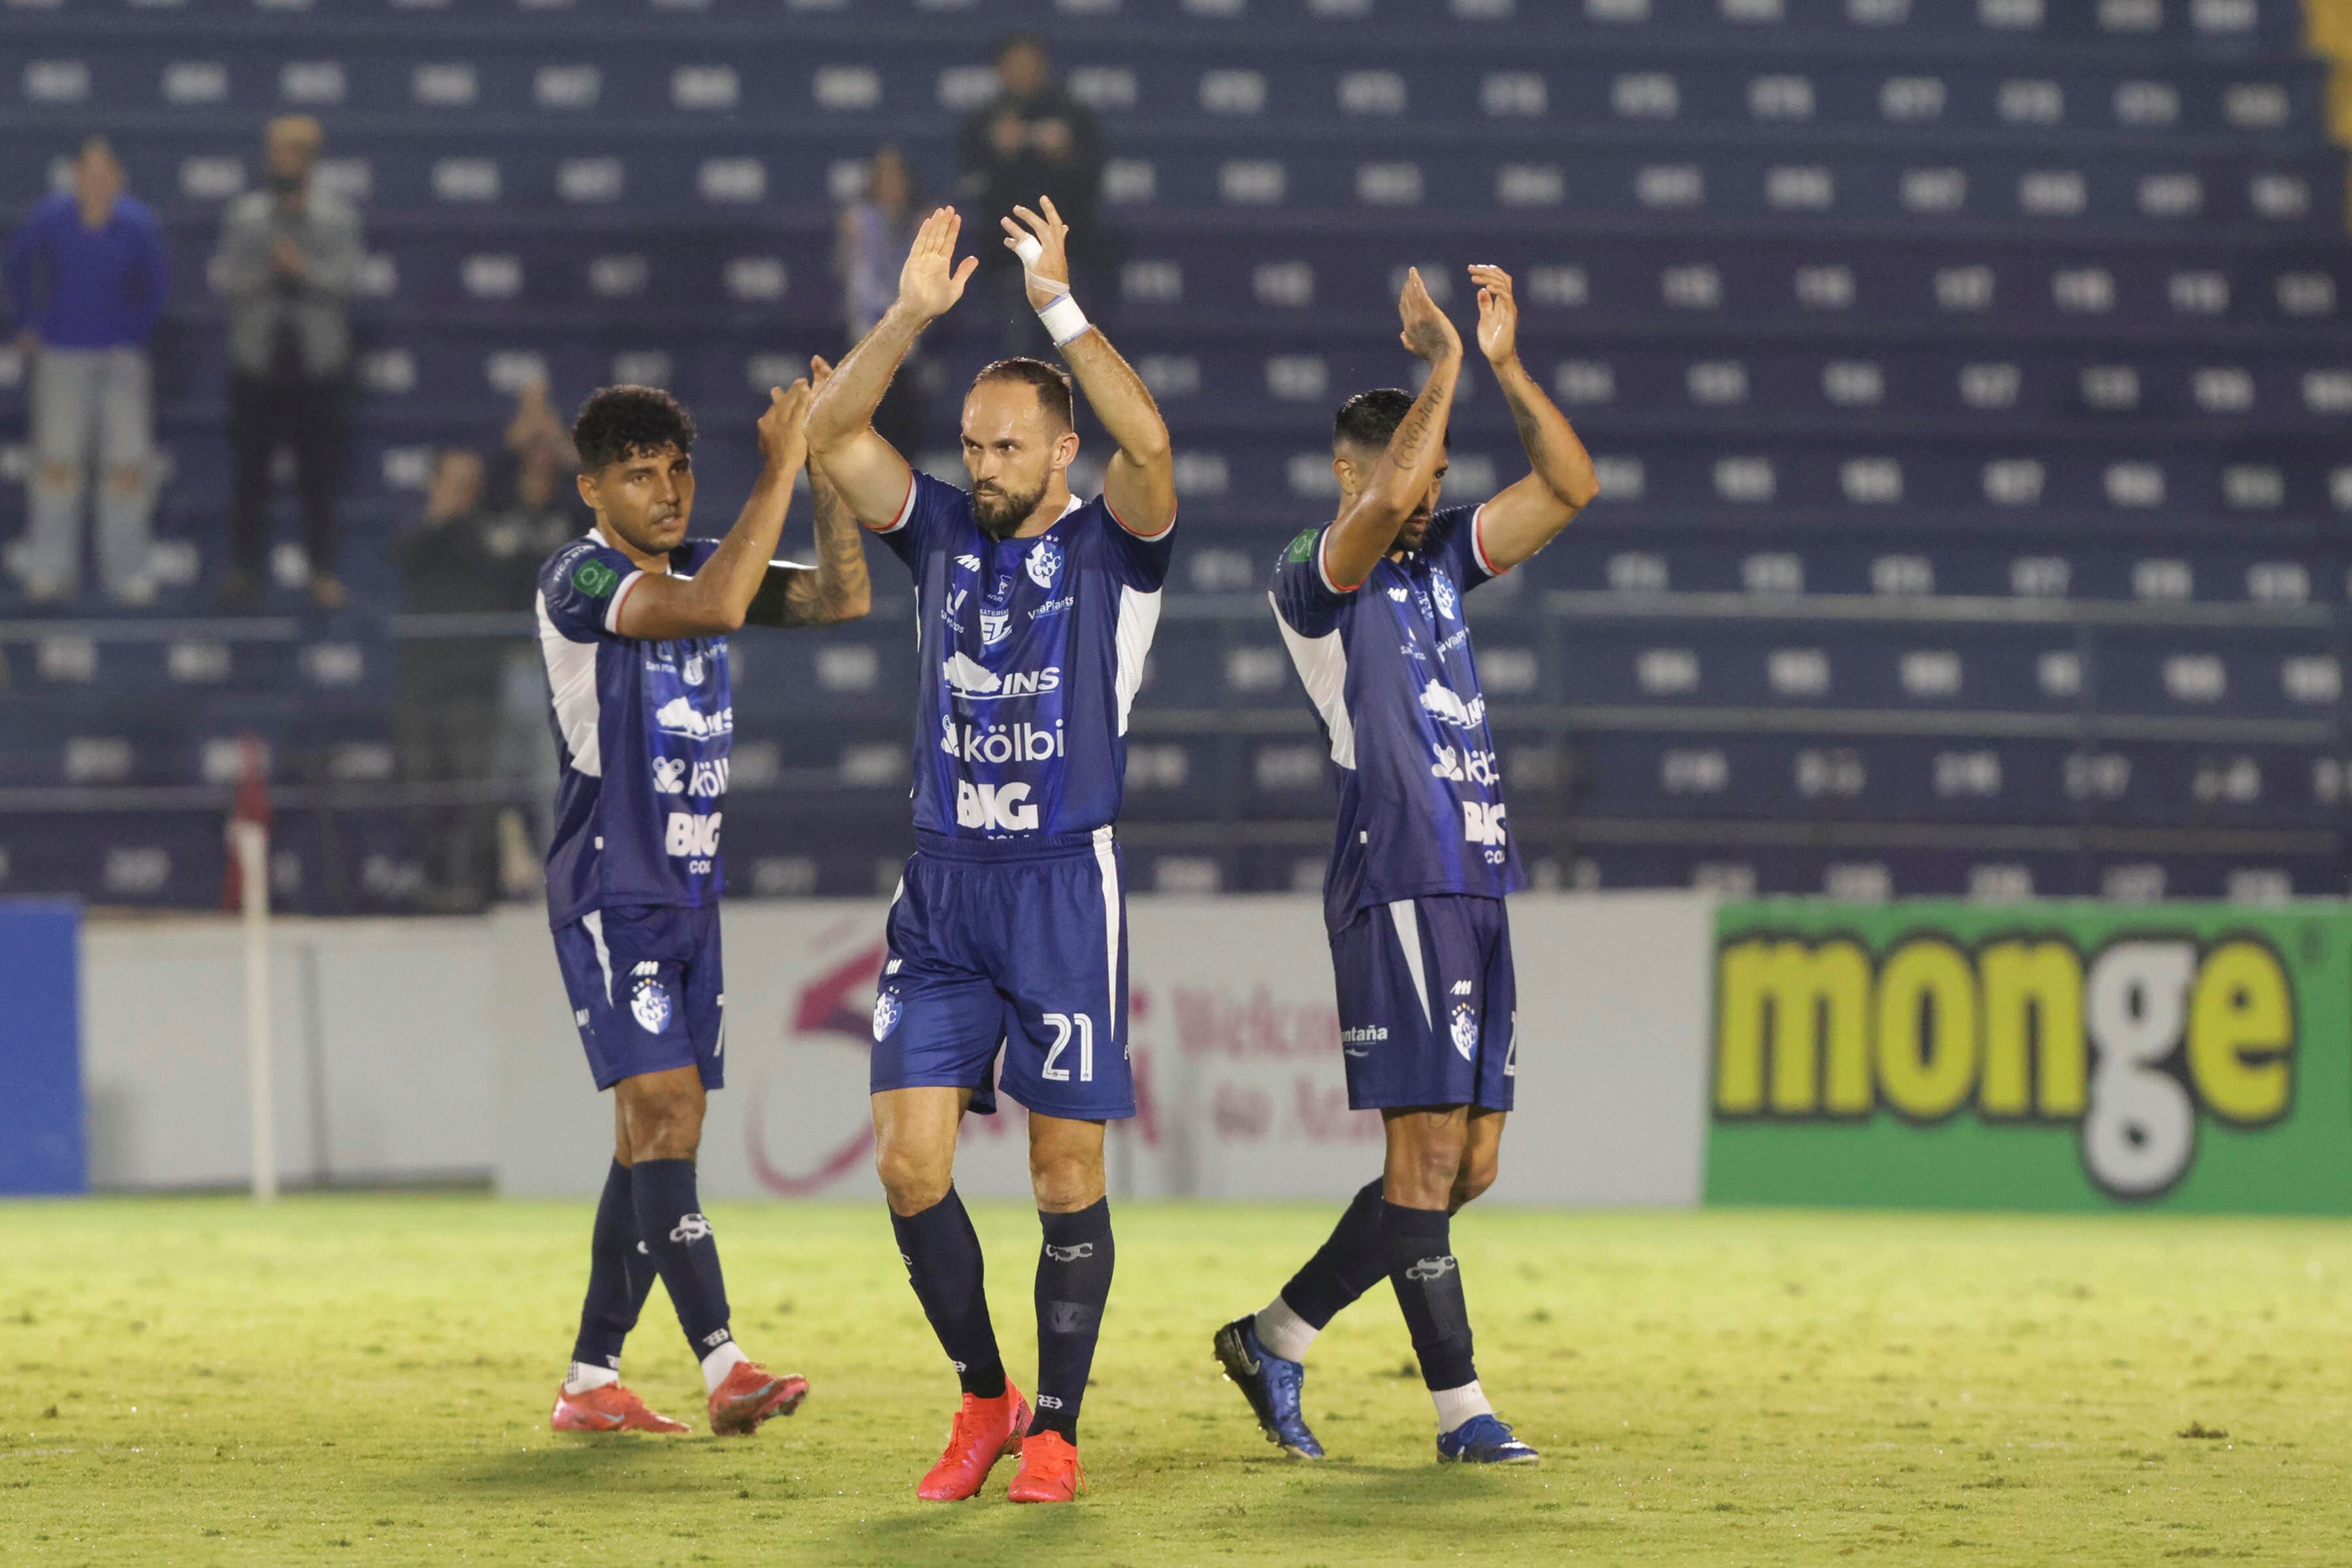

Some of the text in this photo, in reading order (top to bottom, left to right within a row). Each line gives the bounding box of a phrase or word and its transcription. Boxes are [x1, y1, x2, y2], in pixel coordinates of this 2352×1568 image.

[1002, 666, 1060, 694] INS
[964, 719, 1064, 763] kölbi
[956, 777, 1039, 831] BIG
[1042, 1013, 1092, 1081] 21
[1715, 936, 2295, 1196] monge
